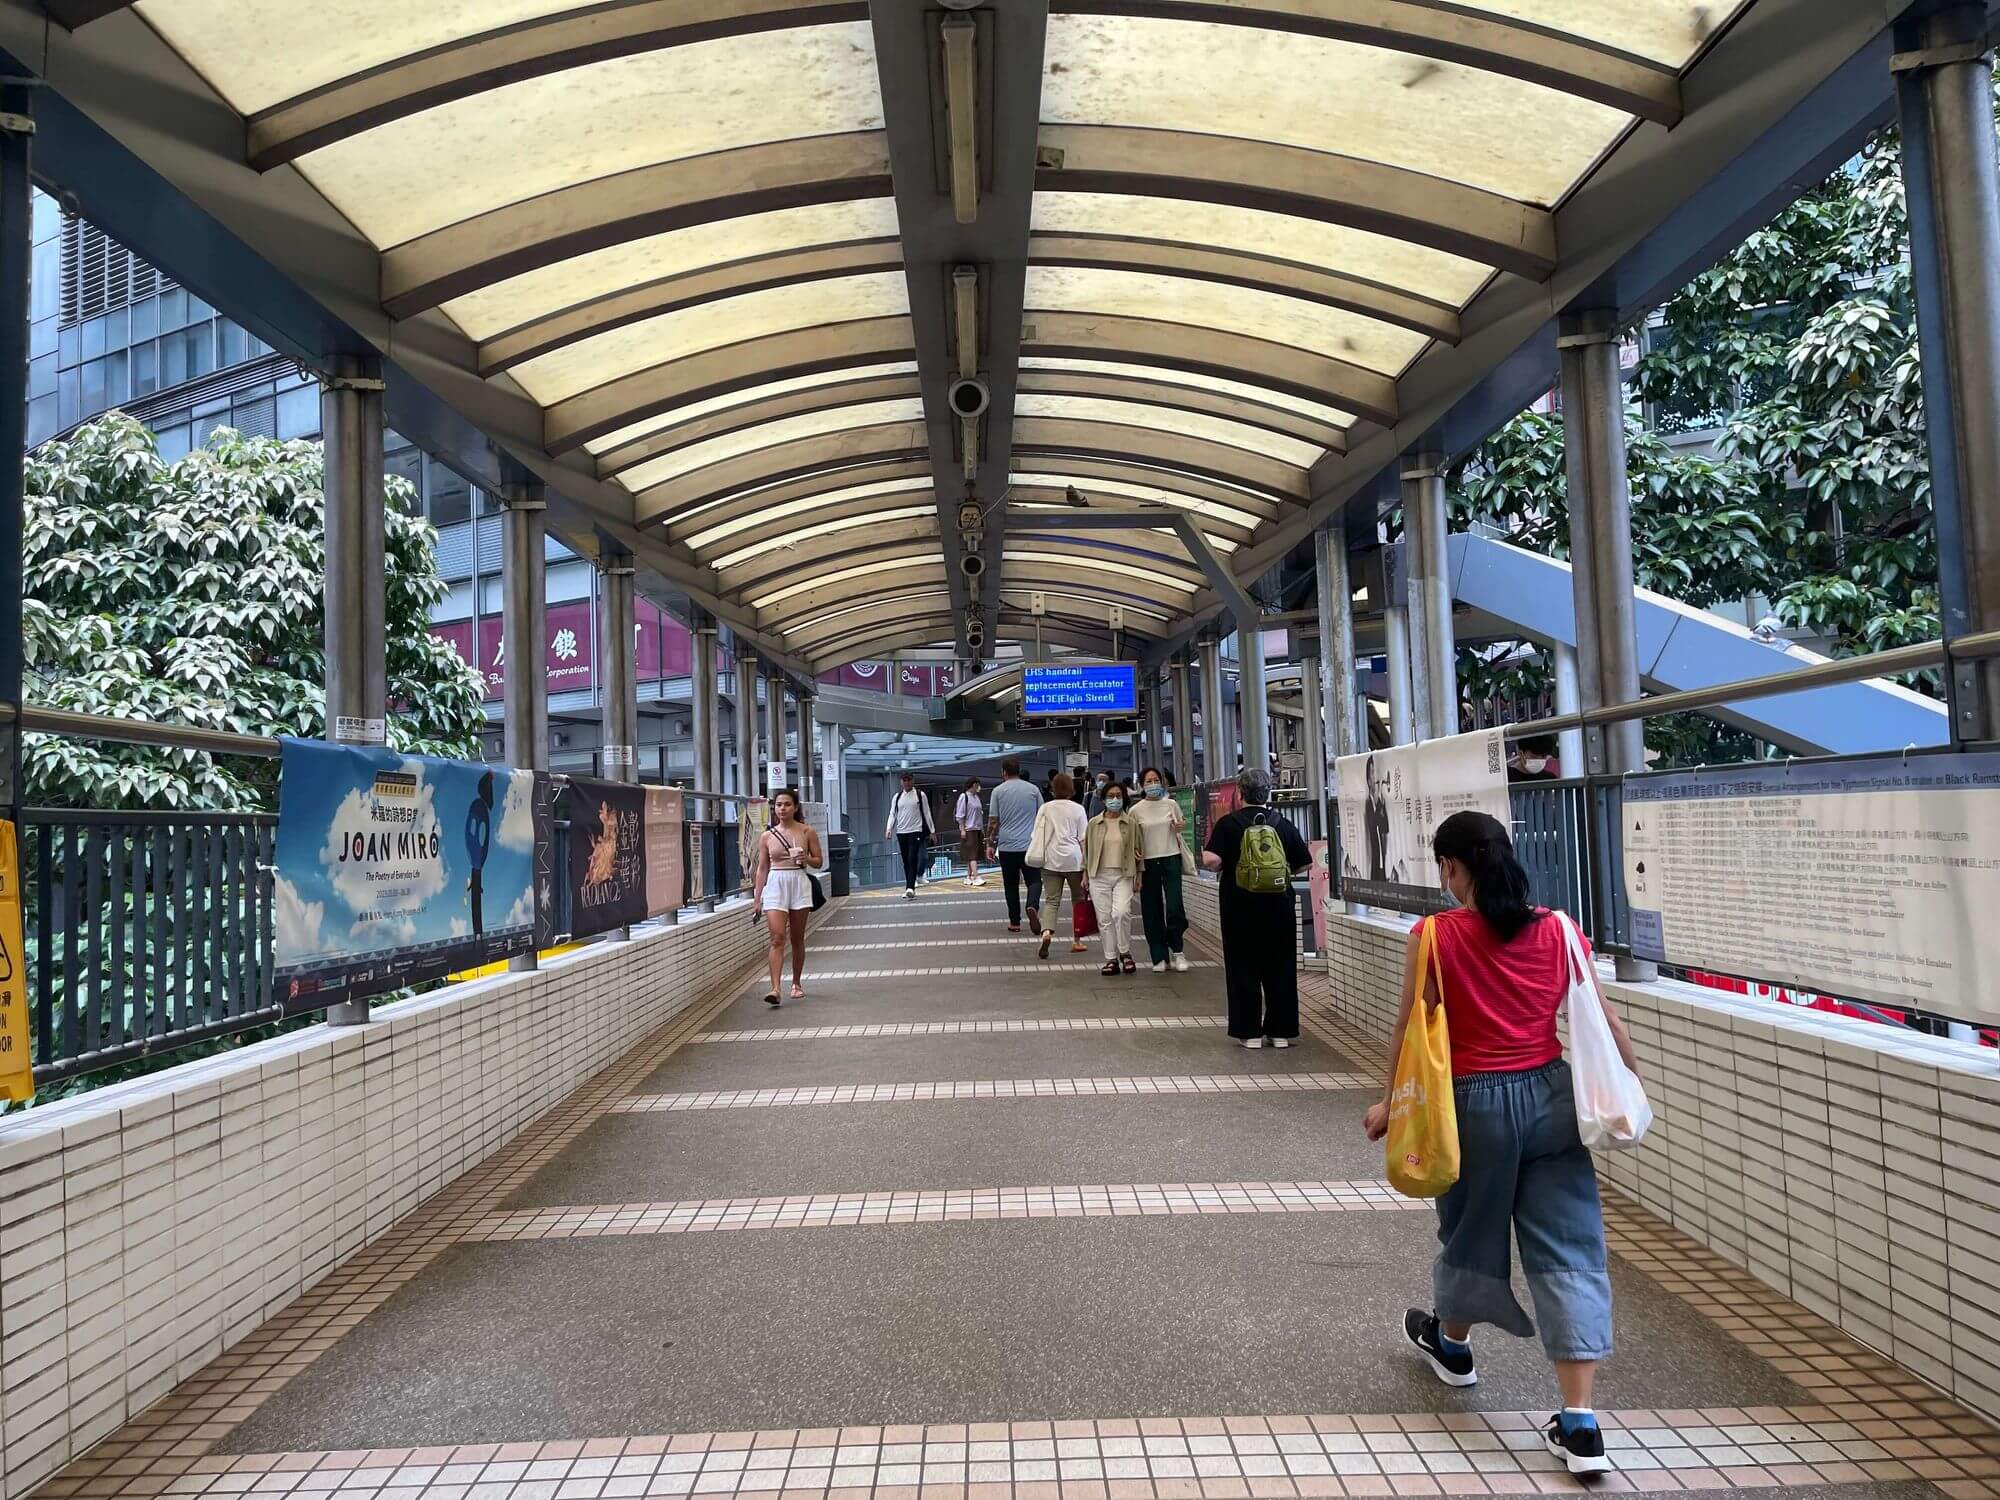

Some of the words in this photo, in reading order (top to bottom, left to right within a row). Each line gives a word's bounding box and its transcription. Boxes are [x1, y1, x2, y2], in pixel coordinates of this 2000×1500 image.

[1025, 667, 1044, 677] LHS
[1046, 667, 1082, 676] handrail
[1945, 774, 1970, 785] Black
[339, 831, 391, 862] JOAN
[398, 823, 439, 860] MIRÓ
[366, 872, 375, 881] The
[375, 871, 390, 880] Poetry
[396, 870, 413, 880] Everyday
